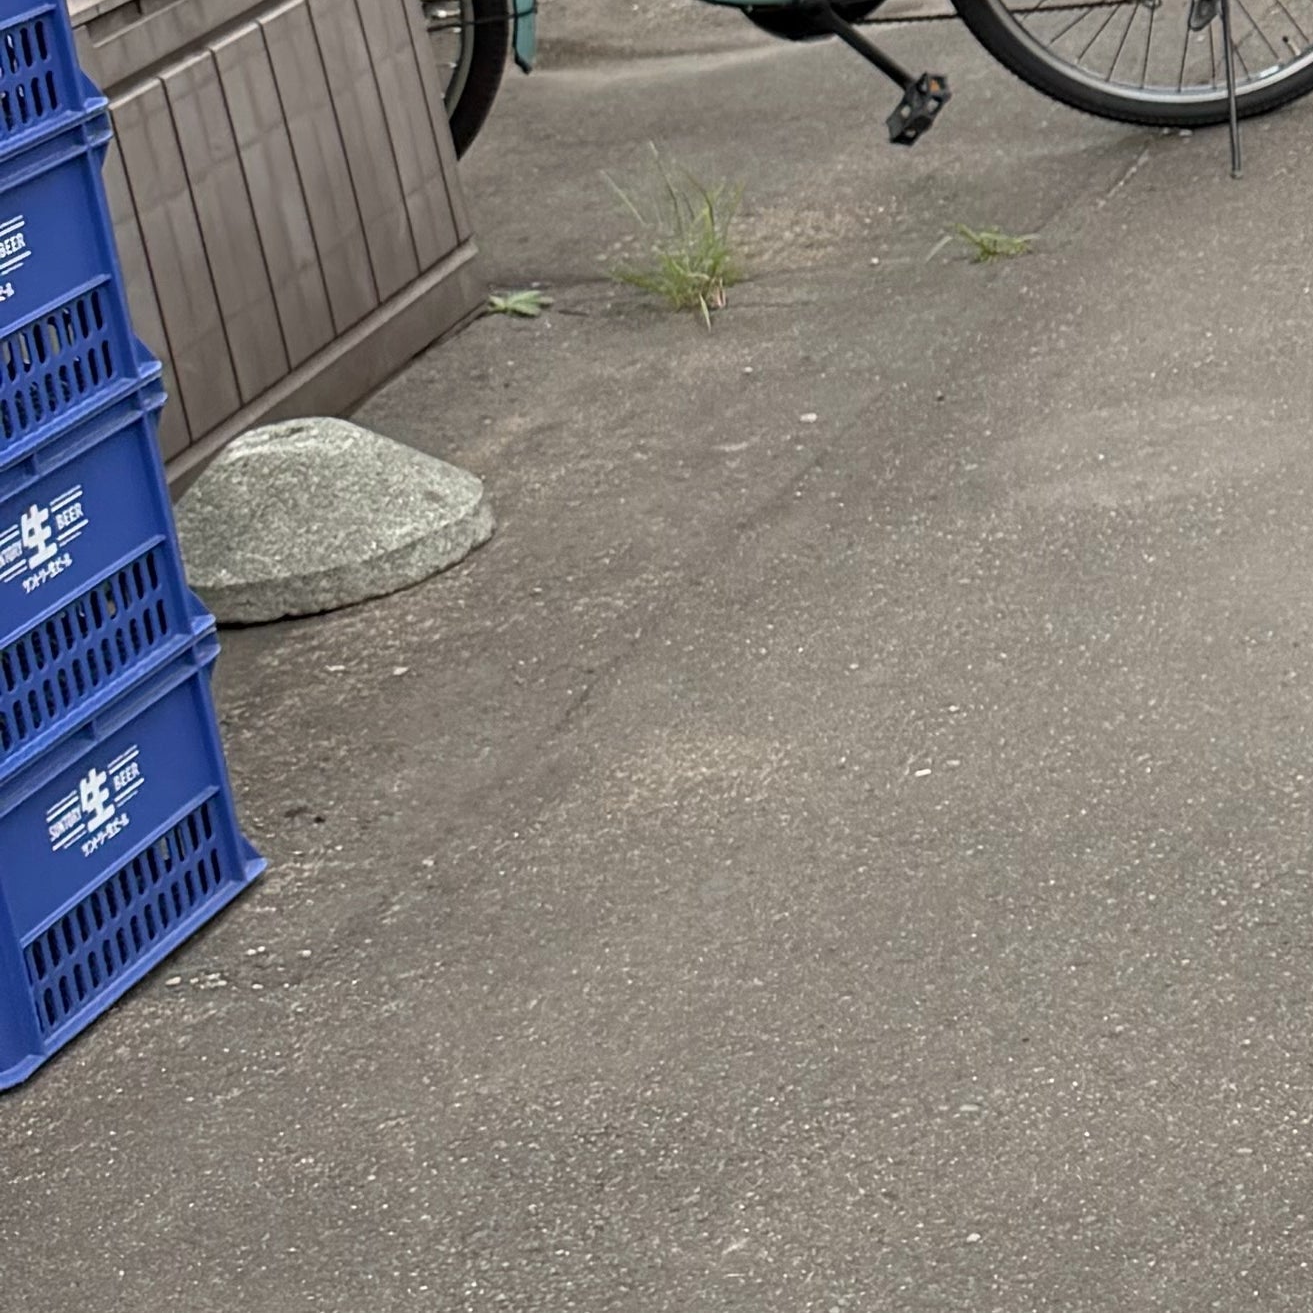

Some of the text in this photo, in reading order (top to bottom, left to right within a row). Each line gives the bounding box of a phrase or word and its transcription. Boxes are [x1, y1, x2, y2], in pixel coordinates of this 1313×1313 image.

[21, 504, 58, 570] 生
[56, 502, 84, 531] BEER
[80, 767, 116, 833] 生
[113, 761, 140, 792] BEER
